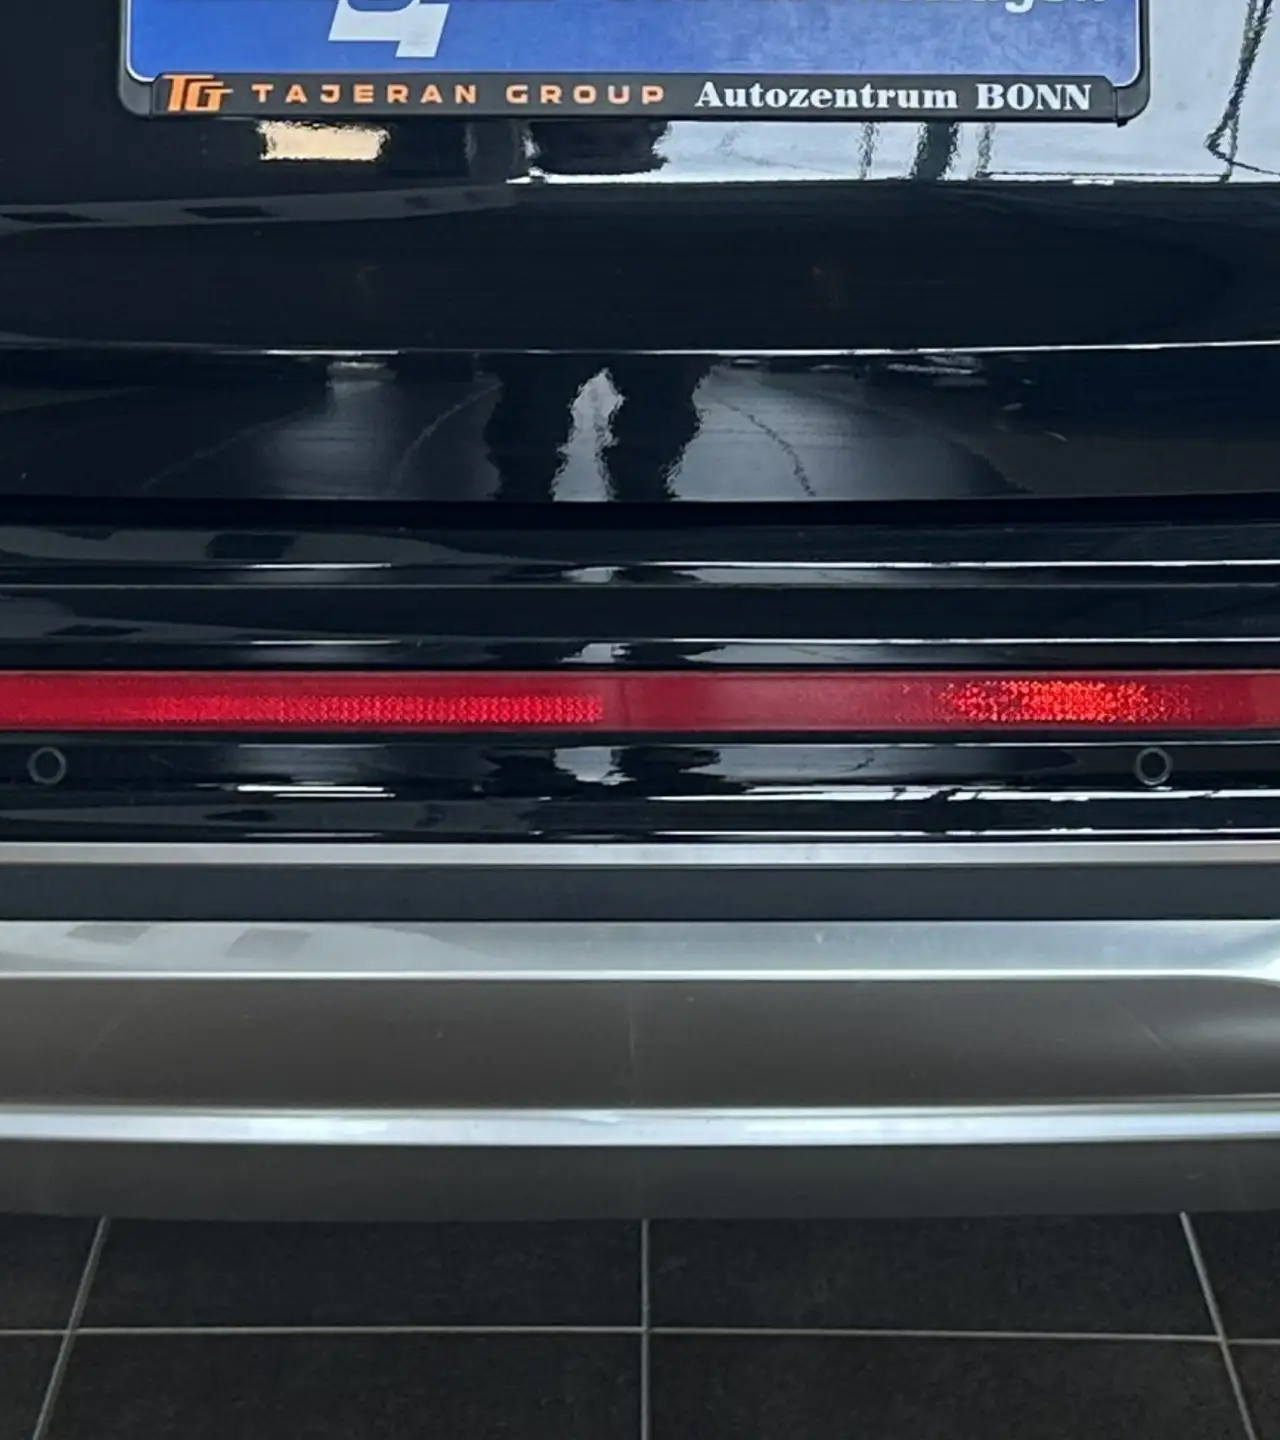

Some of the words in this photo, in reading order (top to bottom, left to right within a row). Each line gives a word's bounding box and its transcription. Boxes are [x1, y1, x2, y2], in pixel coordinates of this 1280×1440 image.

[251, 83, 477, 105] TAJERAN
[505, 83, 666, 105] GROUP
[693, 81, 960, 110] Autozentrum
[974, 82, 1091, 111] BONN
